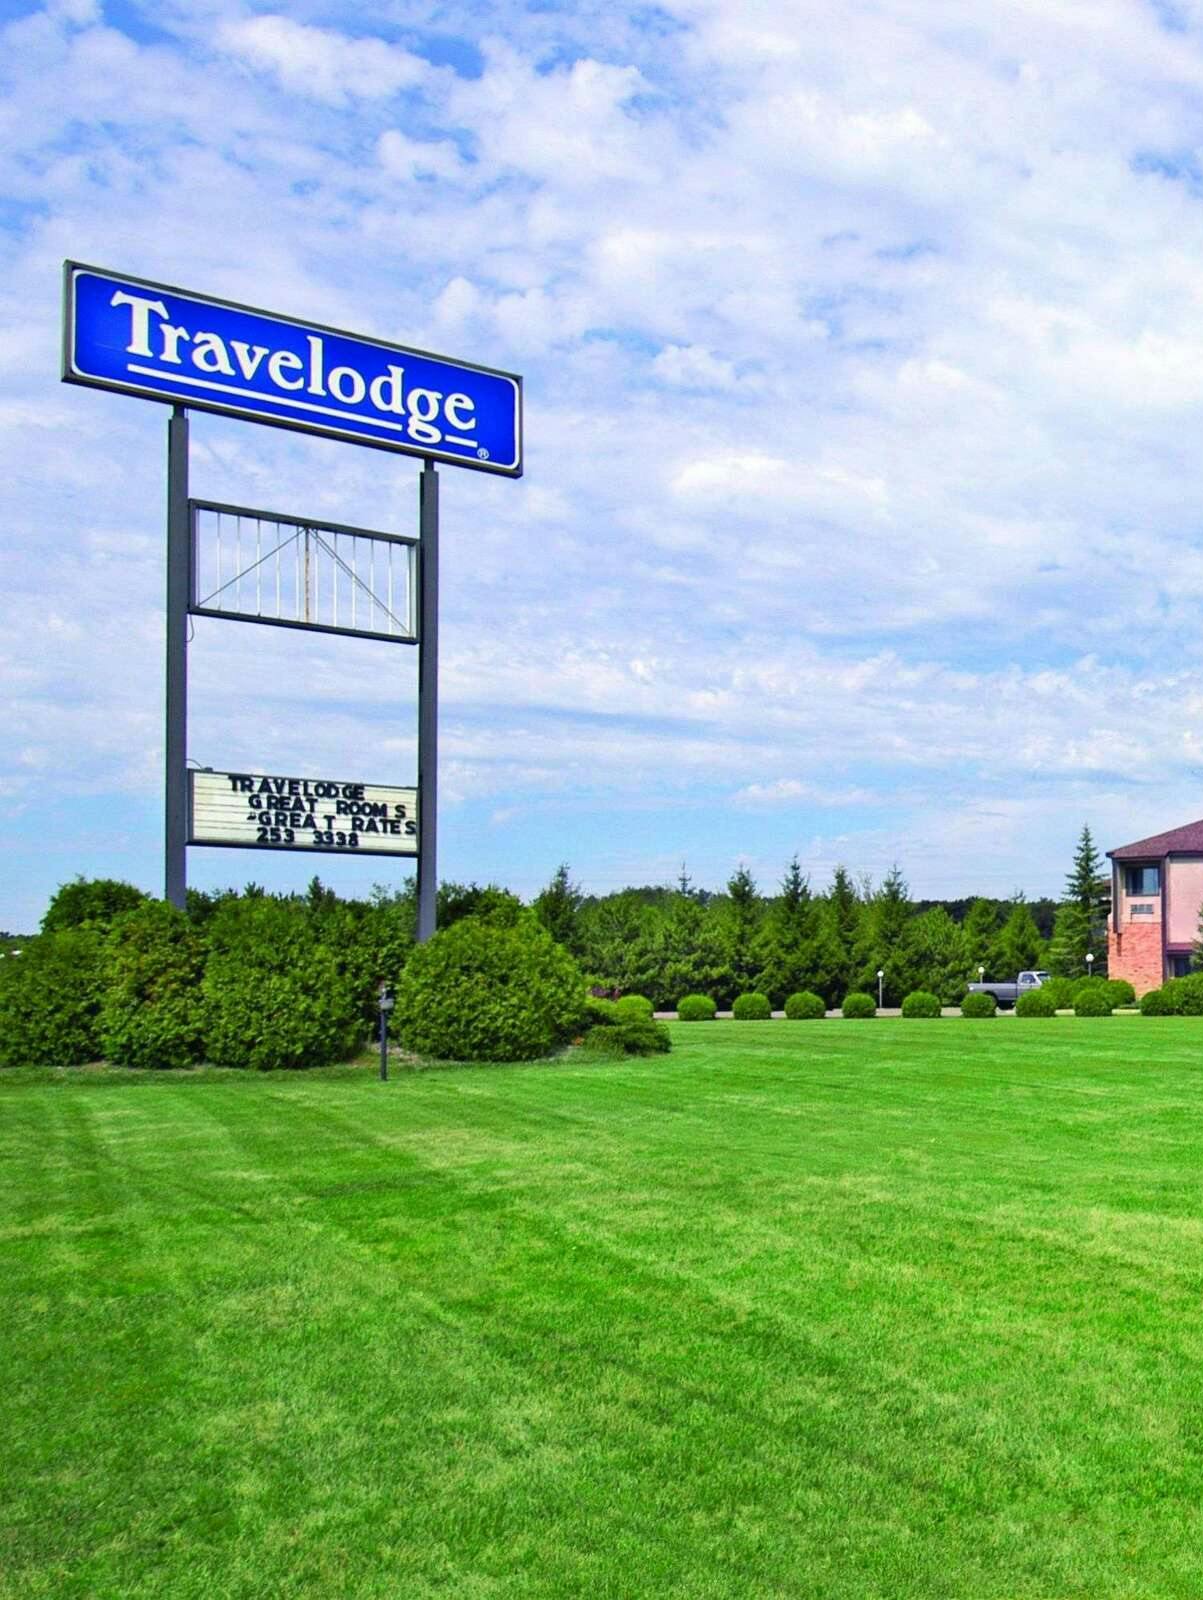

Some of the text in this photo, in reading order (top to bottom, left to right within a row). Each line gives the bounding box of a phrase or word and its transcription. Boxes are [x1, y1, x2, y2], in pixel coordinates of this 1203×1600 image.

[110, 290, 478, 444] Travelodge
[228, 775, 365, 801] TRAVELODGE
[248, 794, 406, 819] GREAT ROOMS
[256, 827, 359, 847] 253 3338
[351, 816, 416, 835] RATES
